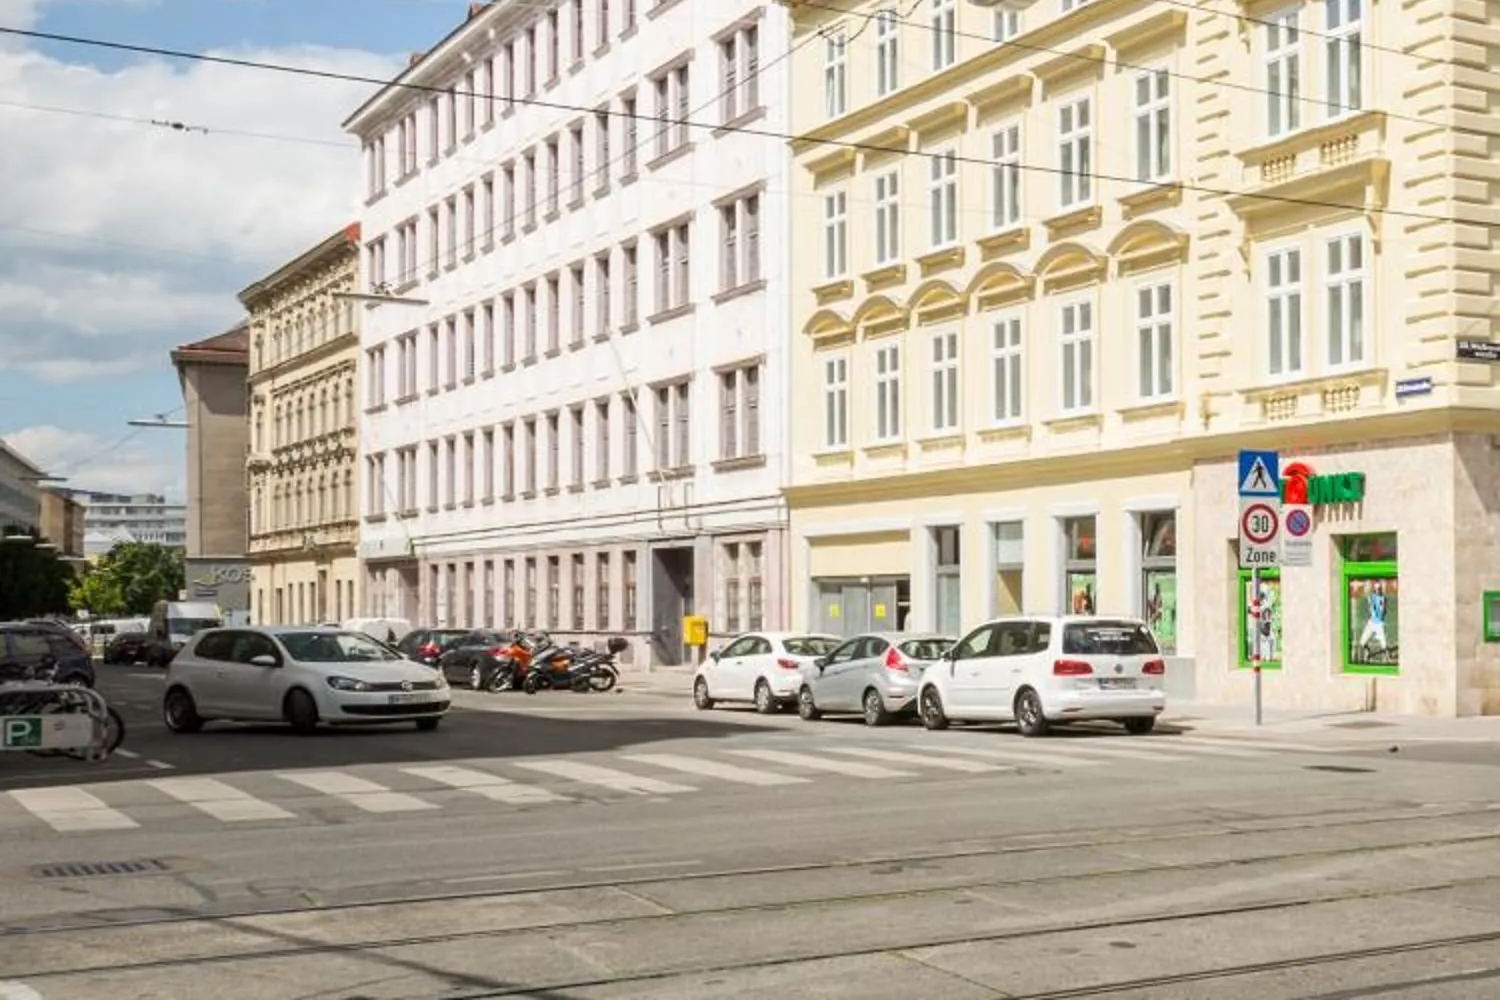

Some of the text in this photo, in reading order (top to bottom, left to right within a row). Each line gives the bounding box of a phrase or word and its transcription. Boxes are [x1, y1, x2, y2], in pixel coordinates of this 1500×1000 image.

[1251, 515, 1269, 532] 30
[1246, 547, 1276, 562] Zone
[6, 721, 32, 745] P
